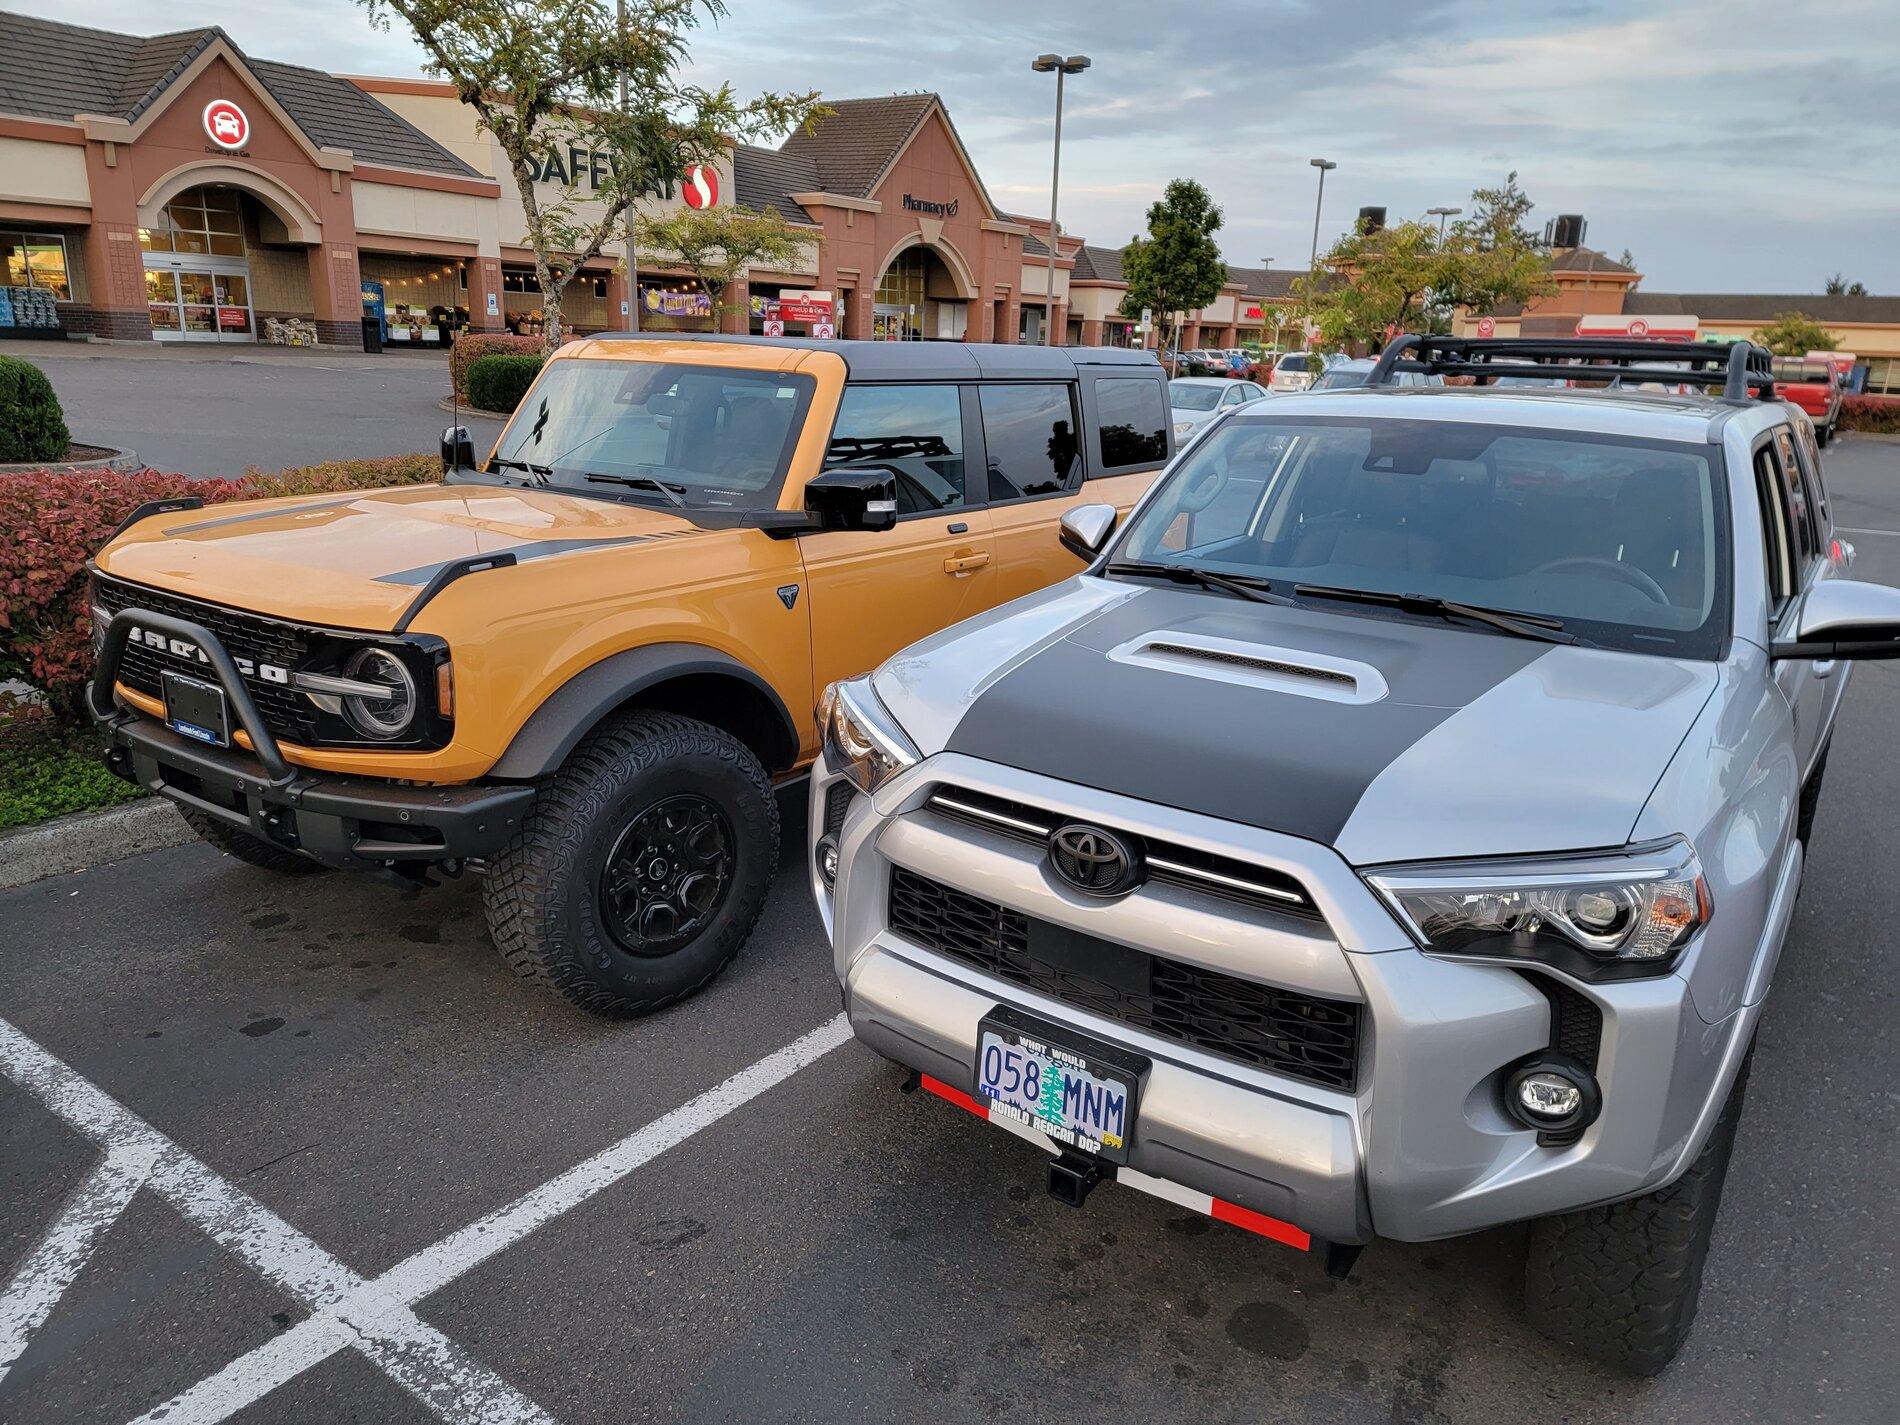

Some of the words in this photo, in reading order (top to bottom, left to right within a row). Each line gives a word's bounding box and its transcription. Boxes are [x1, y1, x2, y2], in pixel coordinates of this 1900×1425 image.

[902, 193, 946, 218] Pharmacy
[1019, 1035, 1047, 1054] WHAT
[1052, 1048, 1087, 1069] WOULD
[985, 1045, 1040, 1101] 058
[1062, 1073, 1124, 1137] MNM
[990, 1098, 1029, 1125] RONALD
[1033, 1115, 1075, 1144] REAGAN
[1078, 1137, 1101, 1155] DO?
